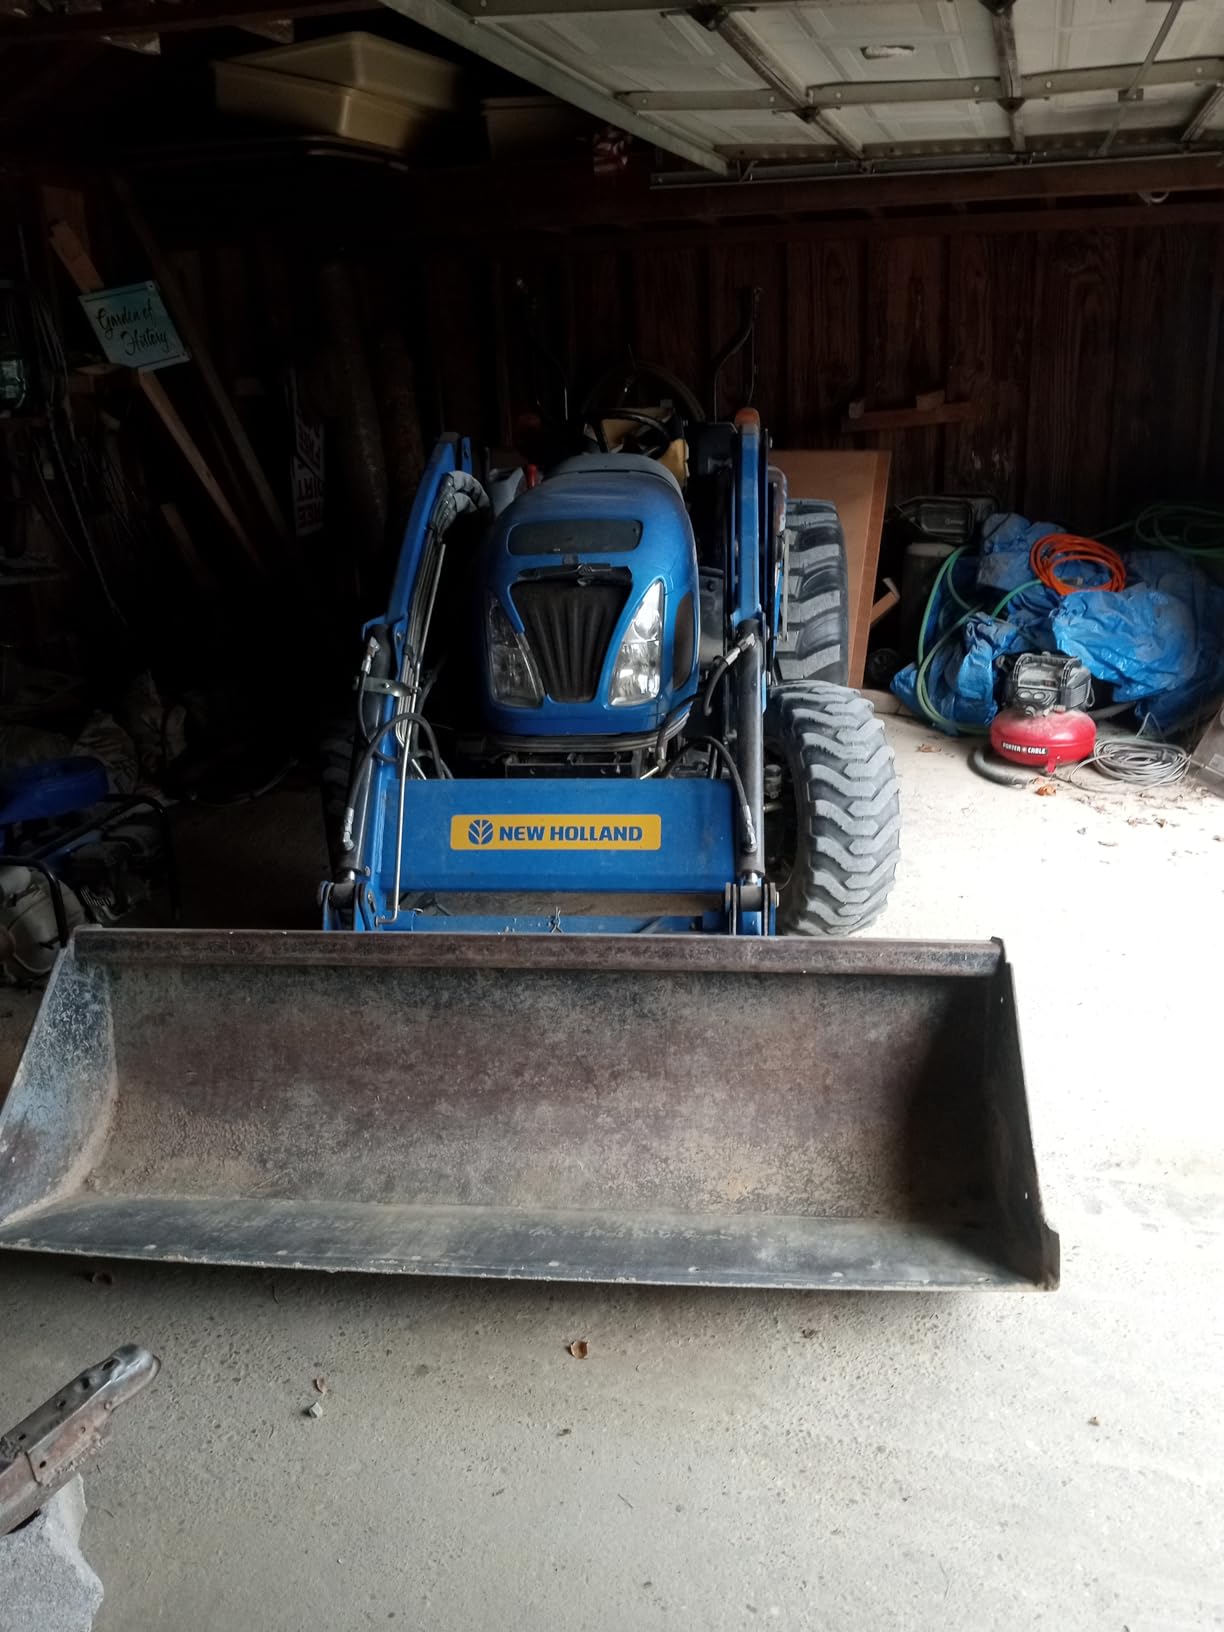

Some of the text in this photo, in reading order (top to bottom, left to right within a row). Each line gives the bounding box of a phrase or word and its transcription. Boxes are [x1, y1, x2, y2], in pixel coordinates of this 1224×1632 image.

[97, 306, 140, 338] Garden
[121, 328, 169, 356] History
[1003, 742, 1046, 755] PORTER CABLE
[499, 826, 643, 842] NEW HOLLAND
